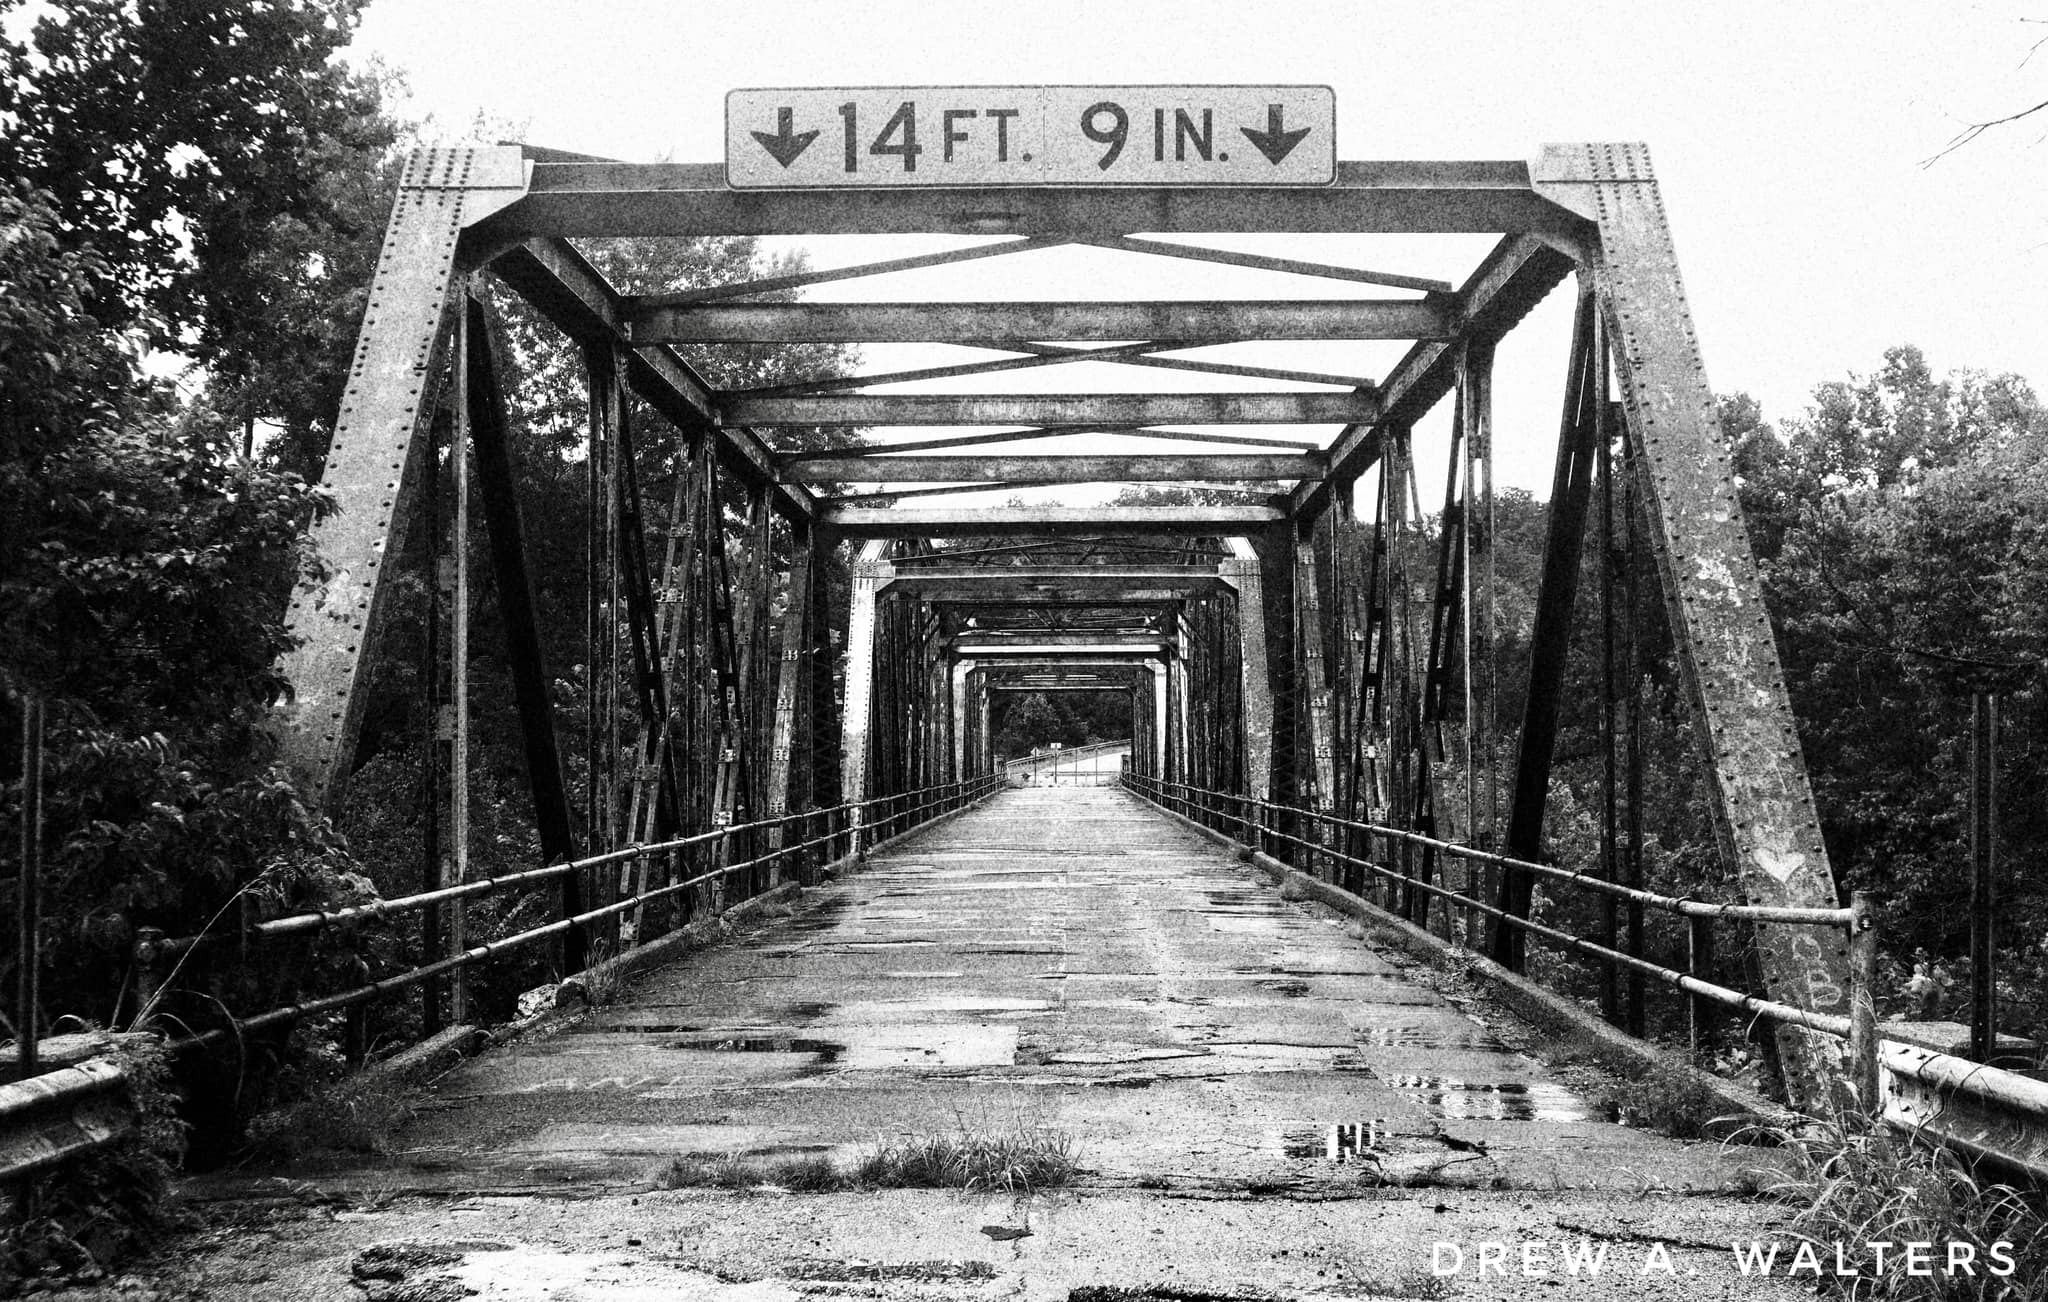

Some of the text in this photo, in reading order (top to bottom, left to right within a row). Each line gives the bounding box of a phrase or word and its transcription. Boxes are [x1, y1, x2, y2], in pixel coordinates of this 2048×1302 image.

[837, 101, 1230, 173] 14 FT. 9 IN.
